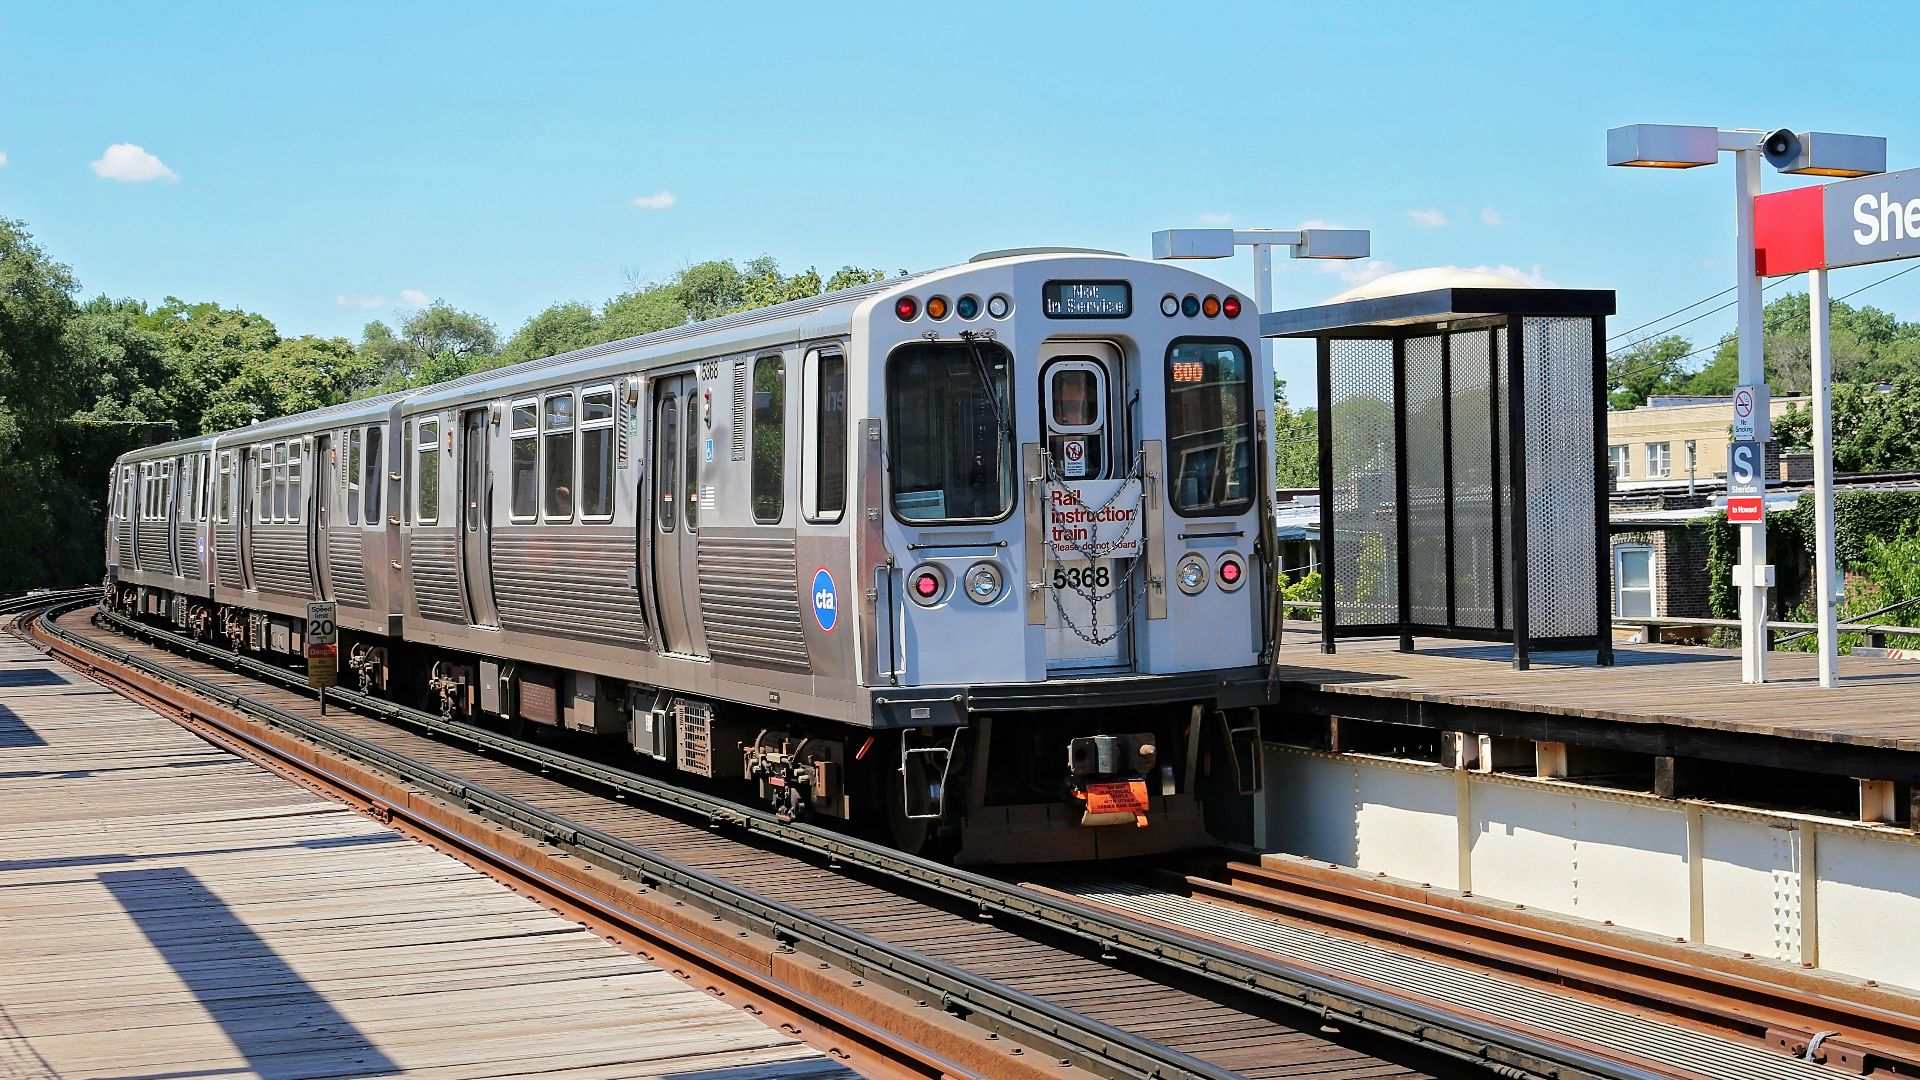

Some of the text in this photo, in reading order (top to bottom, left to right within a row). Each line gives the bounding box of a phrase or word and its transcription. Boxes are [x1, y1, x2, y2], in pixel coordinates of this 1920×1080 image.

[1073, 285, 1099, 299] Not
[1047, 298, 1124, 313] In Service
[702, 361, 719, 381] 5368
[1734, 446, 1753, 484] S
[1731, 485, 1758, 493] Sheridan
[1051, 490, 1081, 506] Rail
[1051, 506, 1136, 524] instruction
[1738, 505, 1757, 513] Howard
[1051, 525, 1088, 541] train
[1082, 542, 1093, 550] do
[1096, 542, 1109, 550] not
[1053, 567, 1110, 590] 5368
[815, 589, 834, 610] cta
[310, 619, 334, 636] 20
